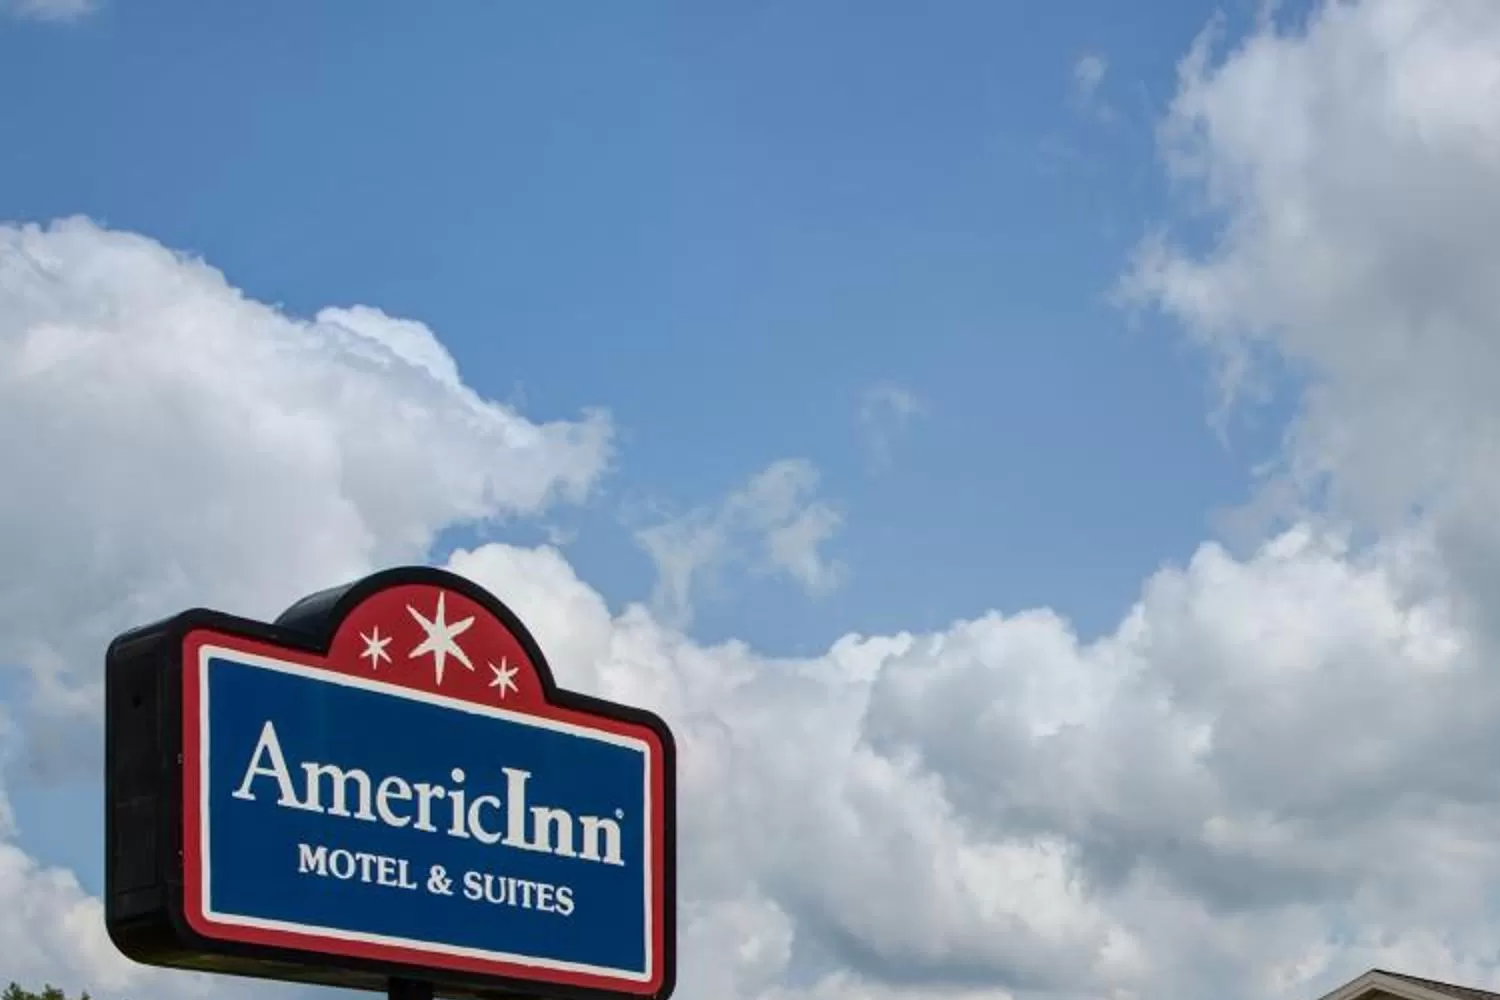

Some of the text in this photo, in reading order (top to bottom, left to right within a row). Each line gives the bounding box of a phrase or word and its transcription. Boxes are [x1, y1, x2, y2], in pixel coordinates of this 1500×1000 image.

[231, 720, 625, 866] AmericInn
[298, 843, 575, 916] MOTEL & SUITES
